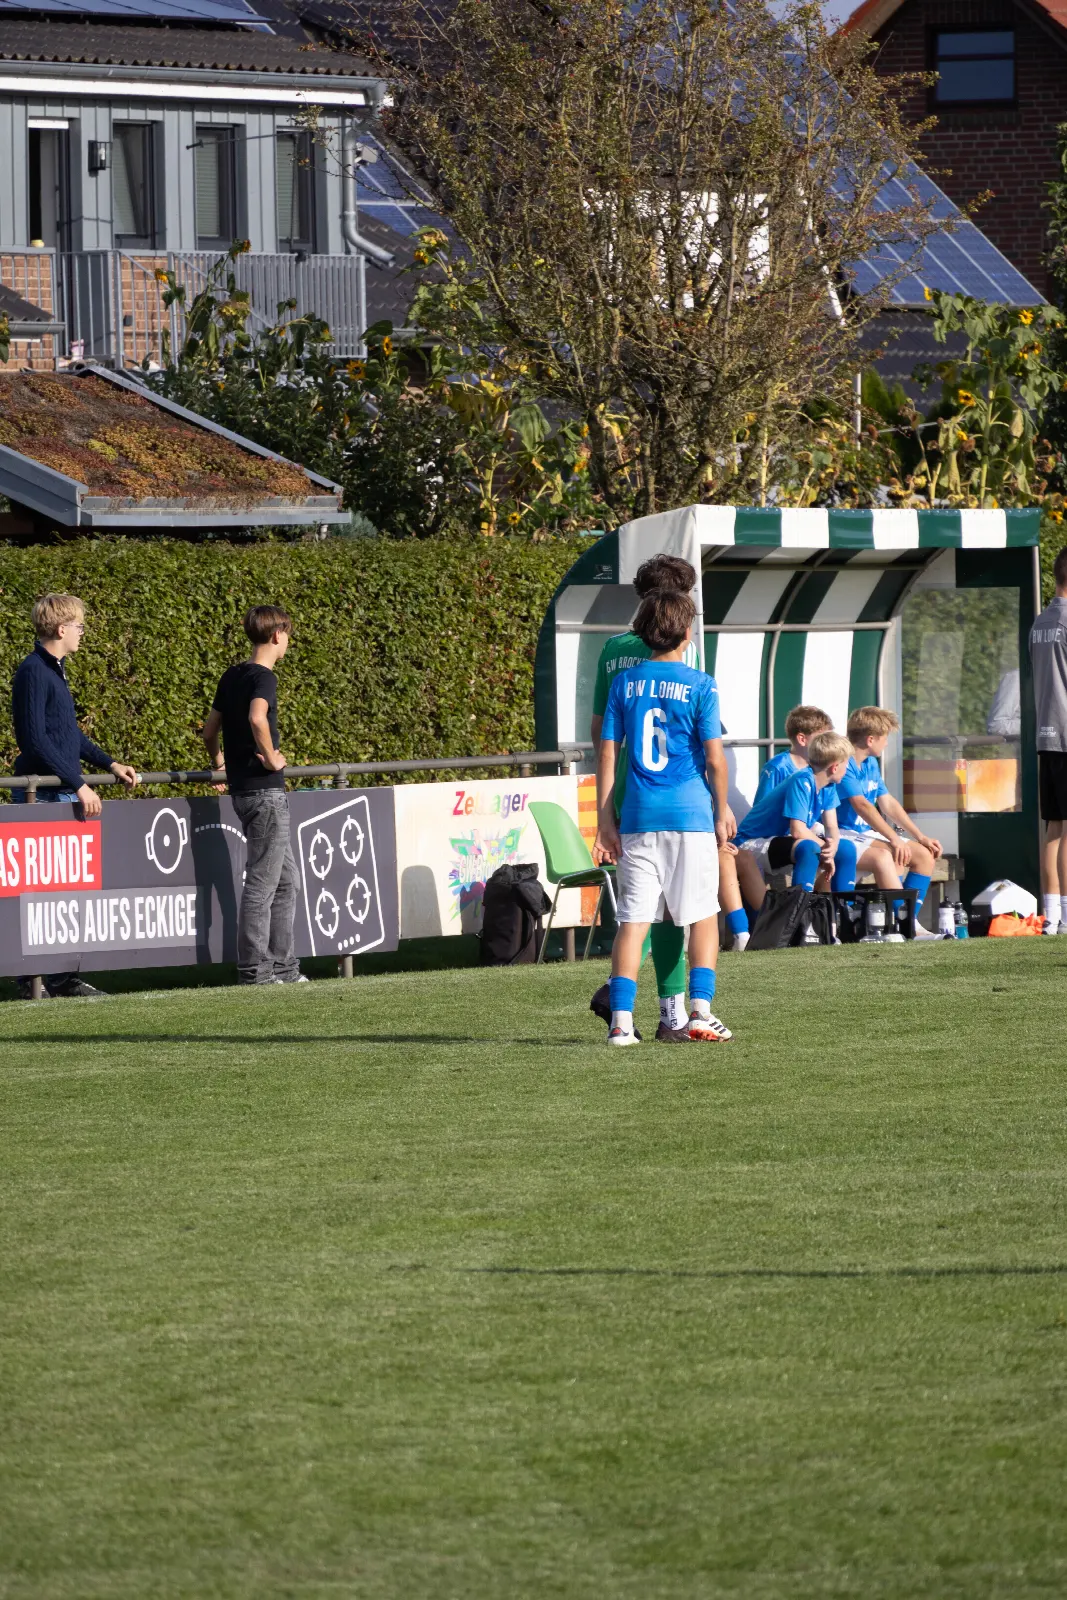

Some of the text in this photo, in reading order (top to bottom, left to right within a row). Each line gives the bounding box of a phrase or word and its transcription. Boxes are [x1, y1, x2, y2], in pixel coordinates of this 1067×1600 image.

[626, 679, 692, 703] BW LOHNE
[642, 707, 669, 772] 6
[24, 834, 95, 886] RUNDE
[27, 893, 198, 946] MUSS AUFS ECKIGE
